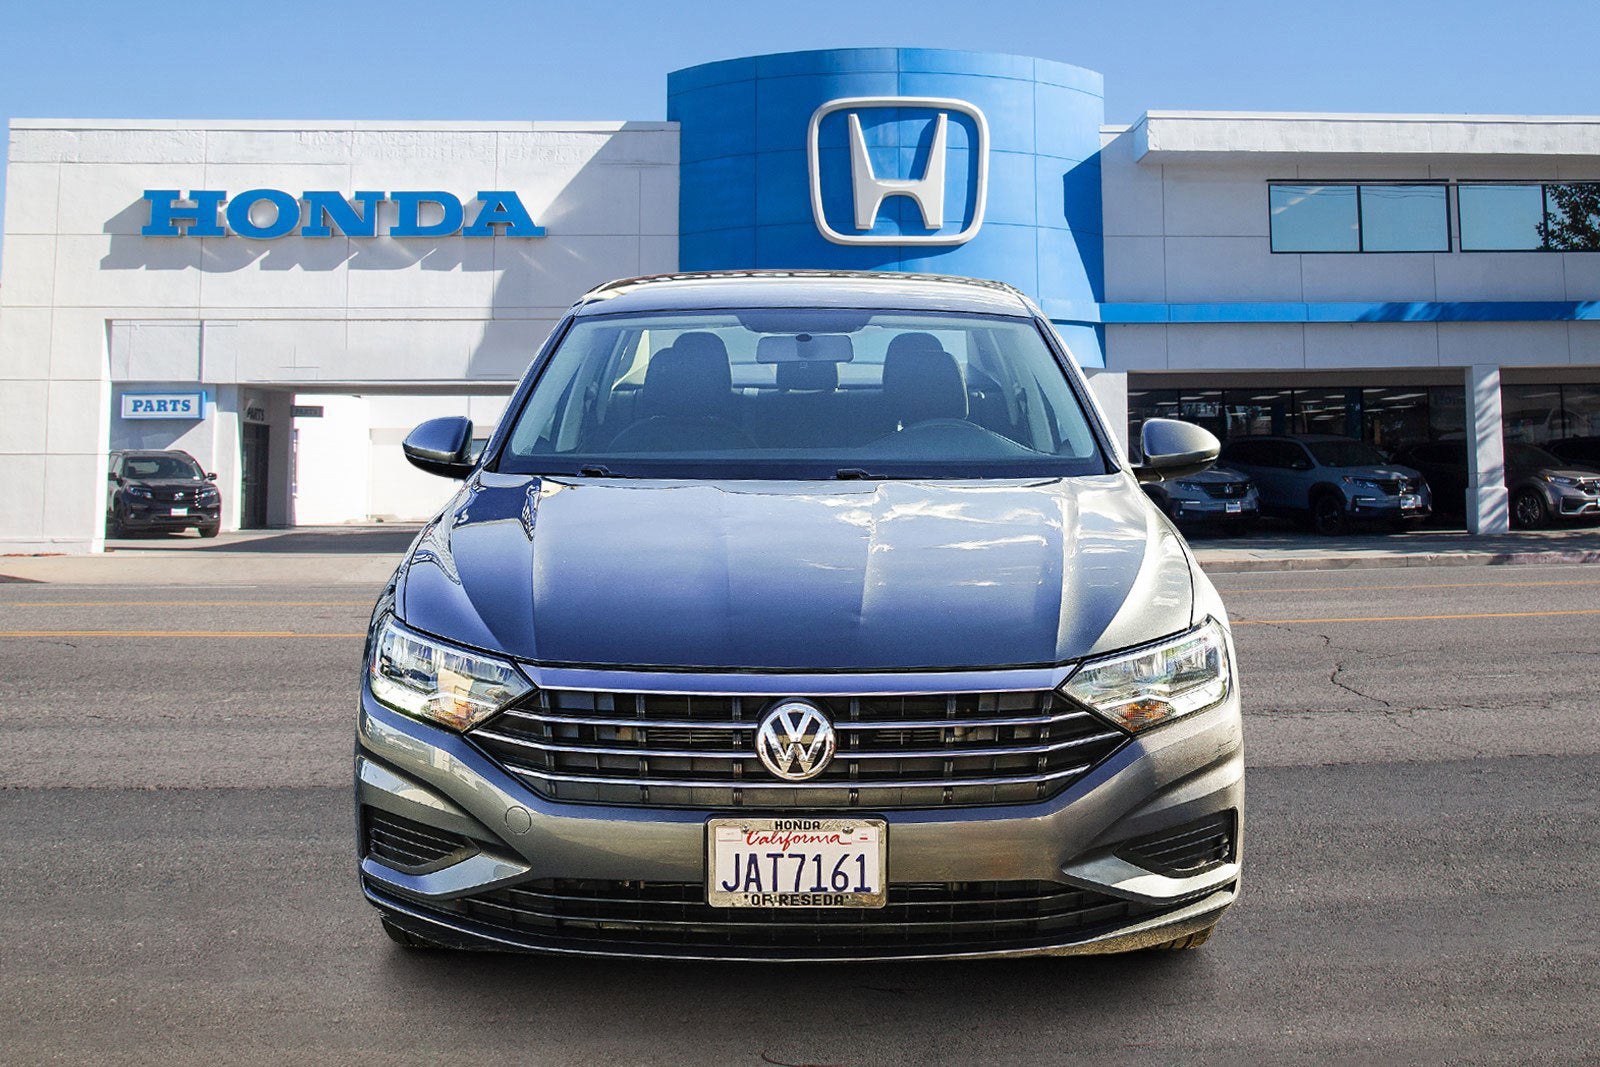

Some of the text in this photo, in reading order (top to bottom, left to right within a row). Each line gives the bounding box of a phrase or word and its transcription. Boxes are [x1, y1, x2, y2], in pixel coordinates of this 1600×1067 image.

[142, 189, 548, 239] HONDA
[132, 399, 191, 413] PARTS
[775, 820, 821, 831] HONDA
[746, 831, 852, 851] California
[721, 853, 872, 893] JAT7161
[779, 893, 844, 906] RESEDA
